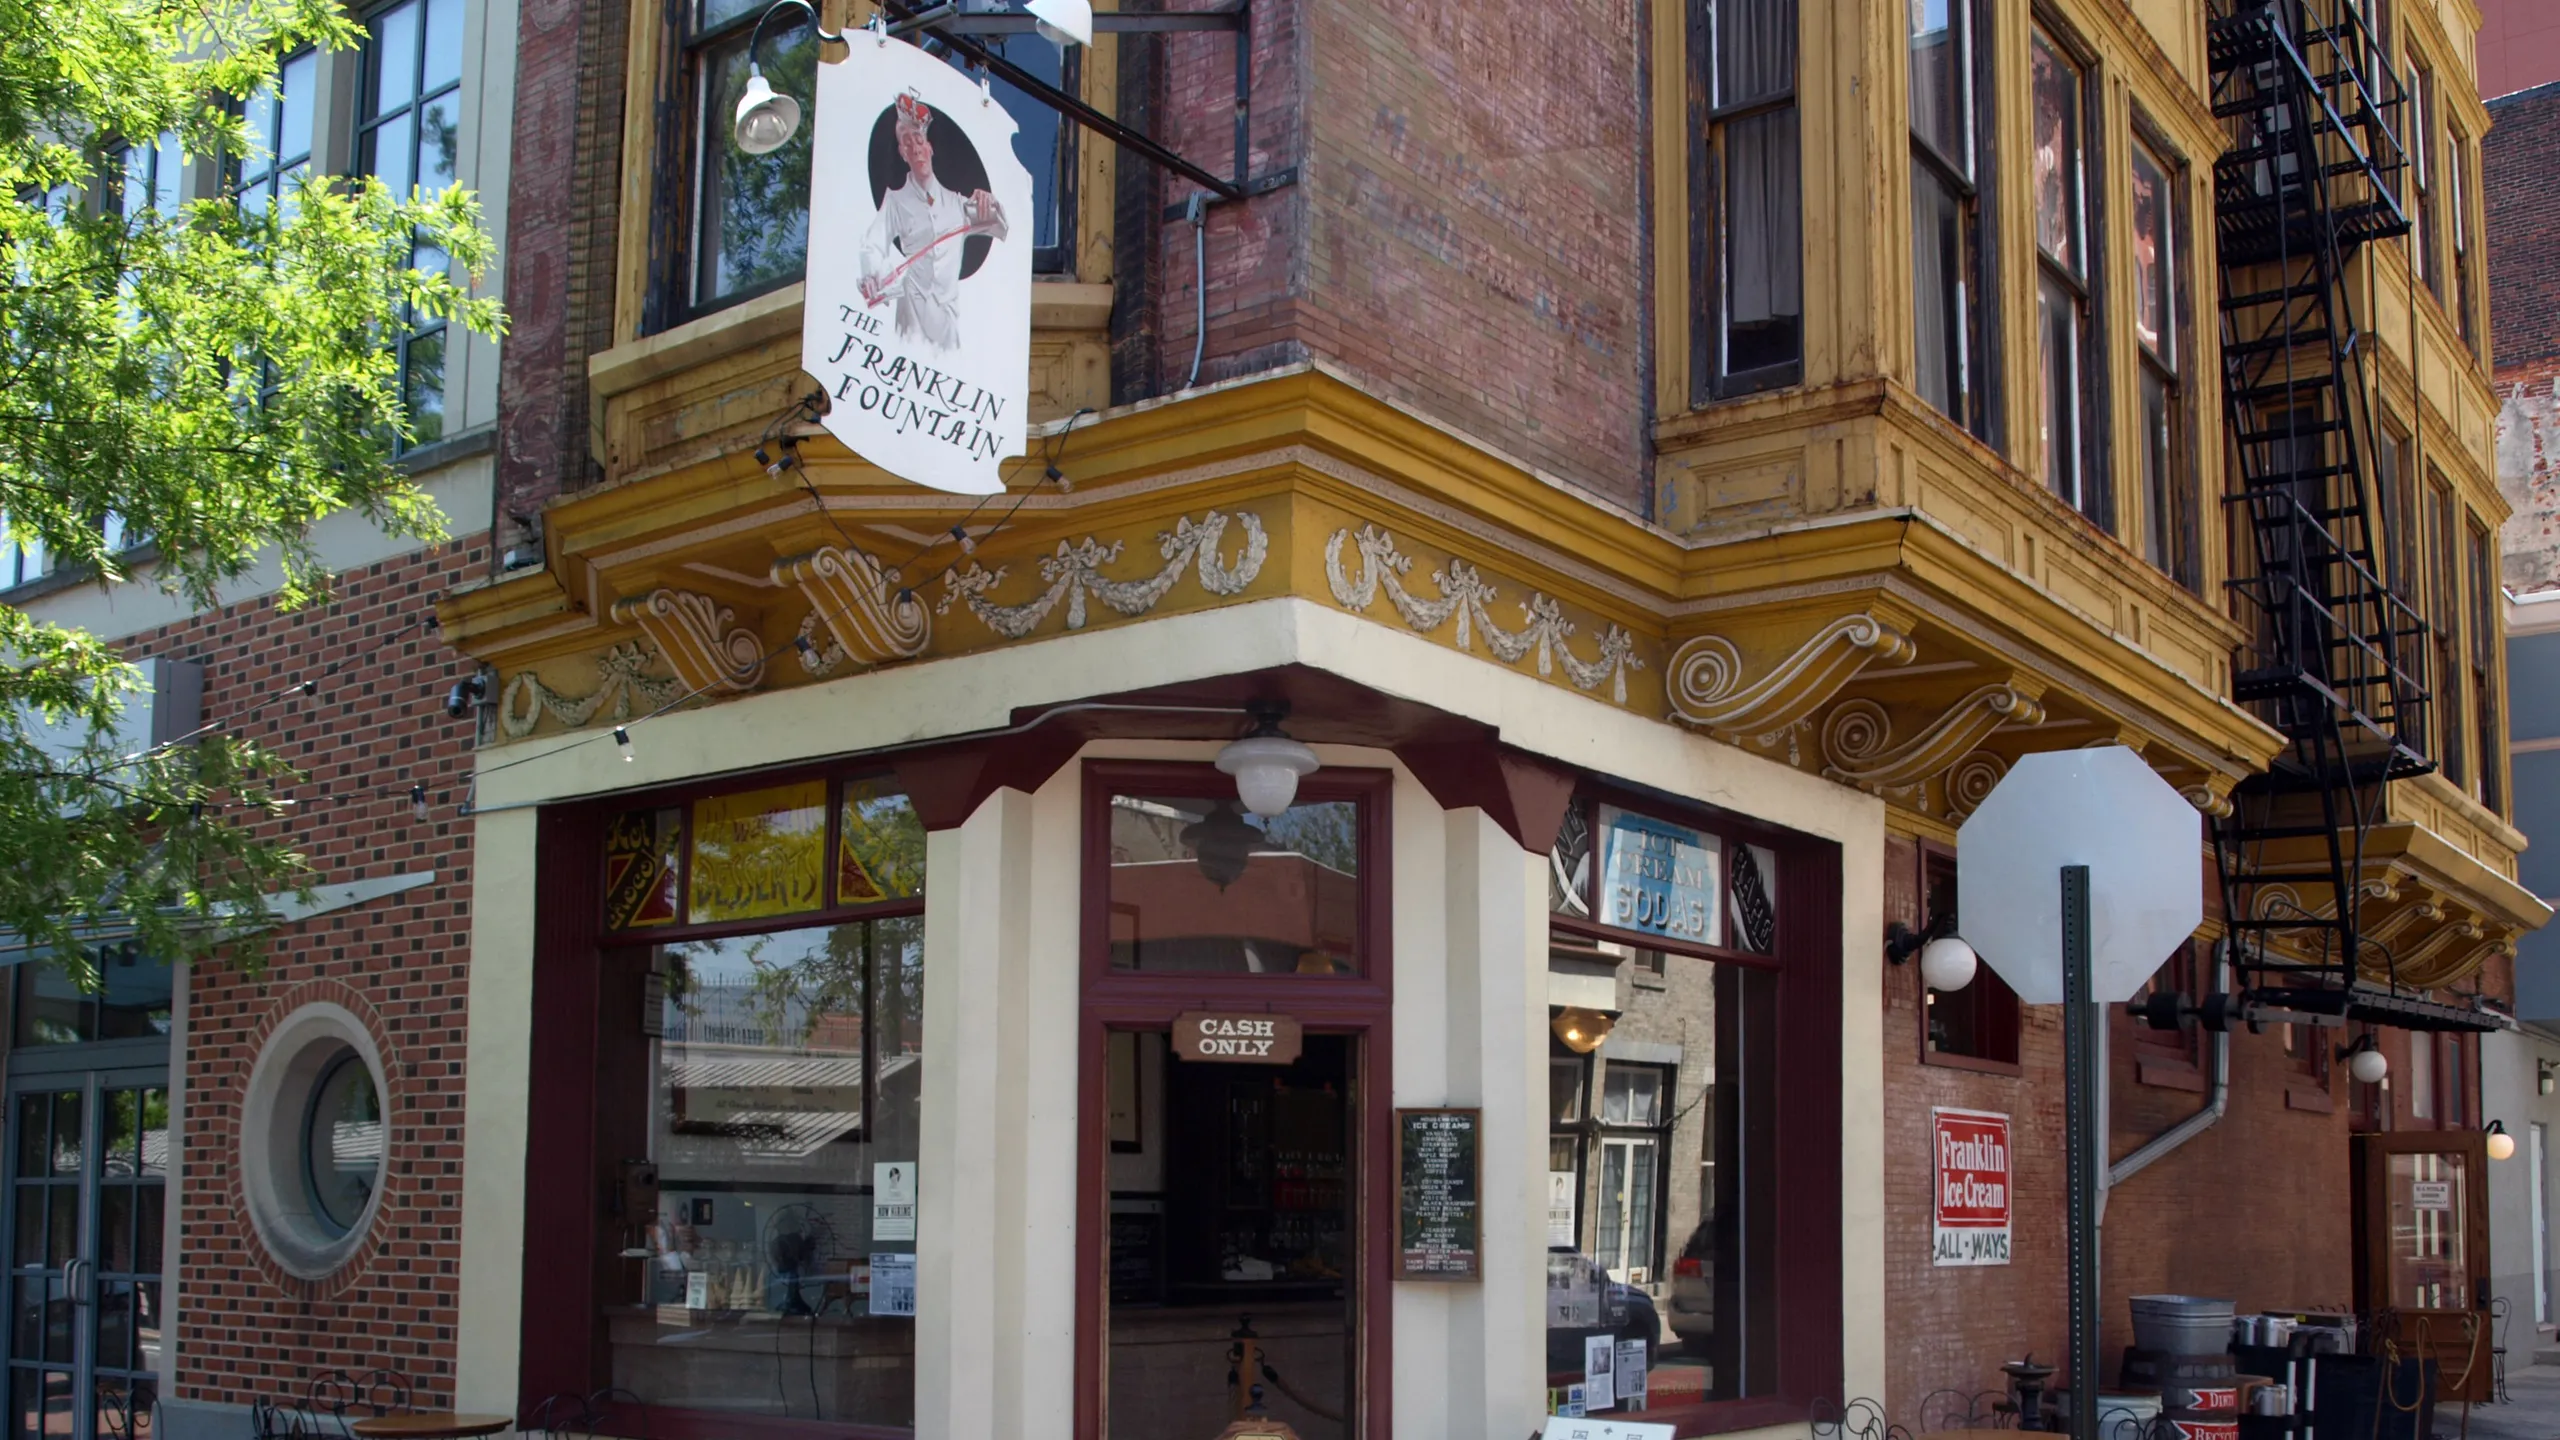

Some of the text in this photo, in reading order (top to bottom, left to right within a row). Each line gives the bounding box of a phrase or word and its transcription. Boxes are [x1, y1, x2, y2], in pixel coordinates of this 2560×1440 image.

[839, 305, 883, 336] THE
[828, 333, 1006, 424] FRANKLIN
[834, 373, 1004, 462] FOUNTAIN
[1638, 829, 1686, 859] ICE
[696, 843, 818, 909] DESSERTS
[1615, 850, 1703, 890] CREAM
[1617, 884, 1704, 937] SODAS
[1199, 1018, 1274, 1037] CASH
[1198, 1038, 1274, 1056] ONLY
[1940, 1131, 2005, 1172] Franklin
[1943, 1171, 2005, 1208] Ice Cream
[878, 1206, 912, 1217] NOW HIRING
